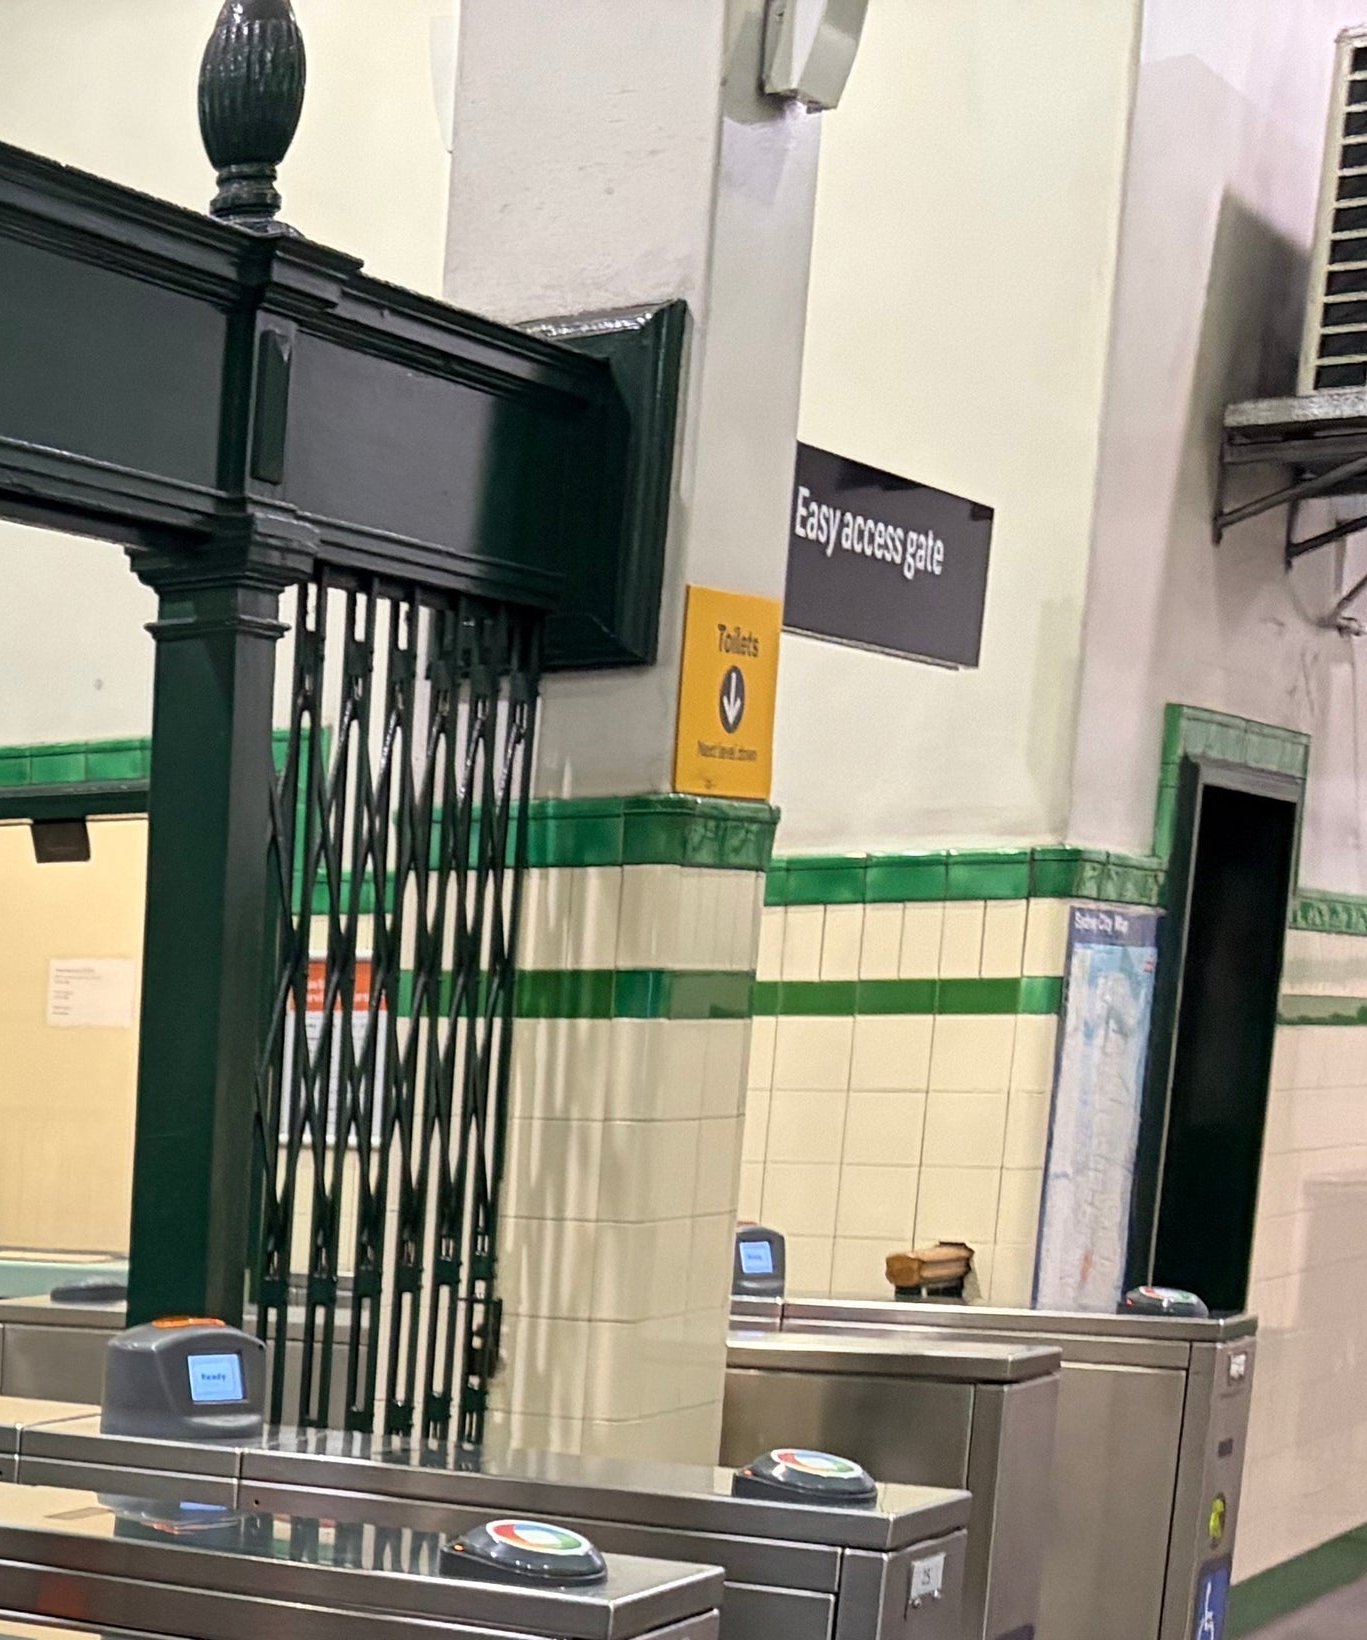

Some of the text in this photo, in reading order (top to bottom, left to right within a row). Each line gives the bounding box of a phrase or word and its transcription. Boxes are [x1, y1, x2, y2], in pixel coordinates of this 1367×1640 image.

[795, 485, 945, 580] Easy access gate
[717, 624, 759, 658] Toilets
